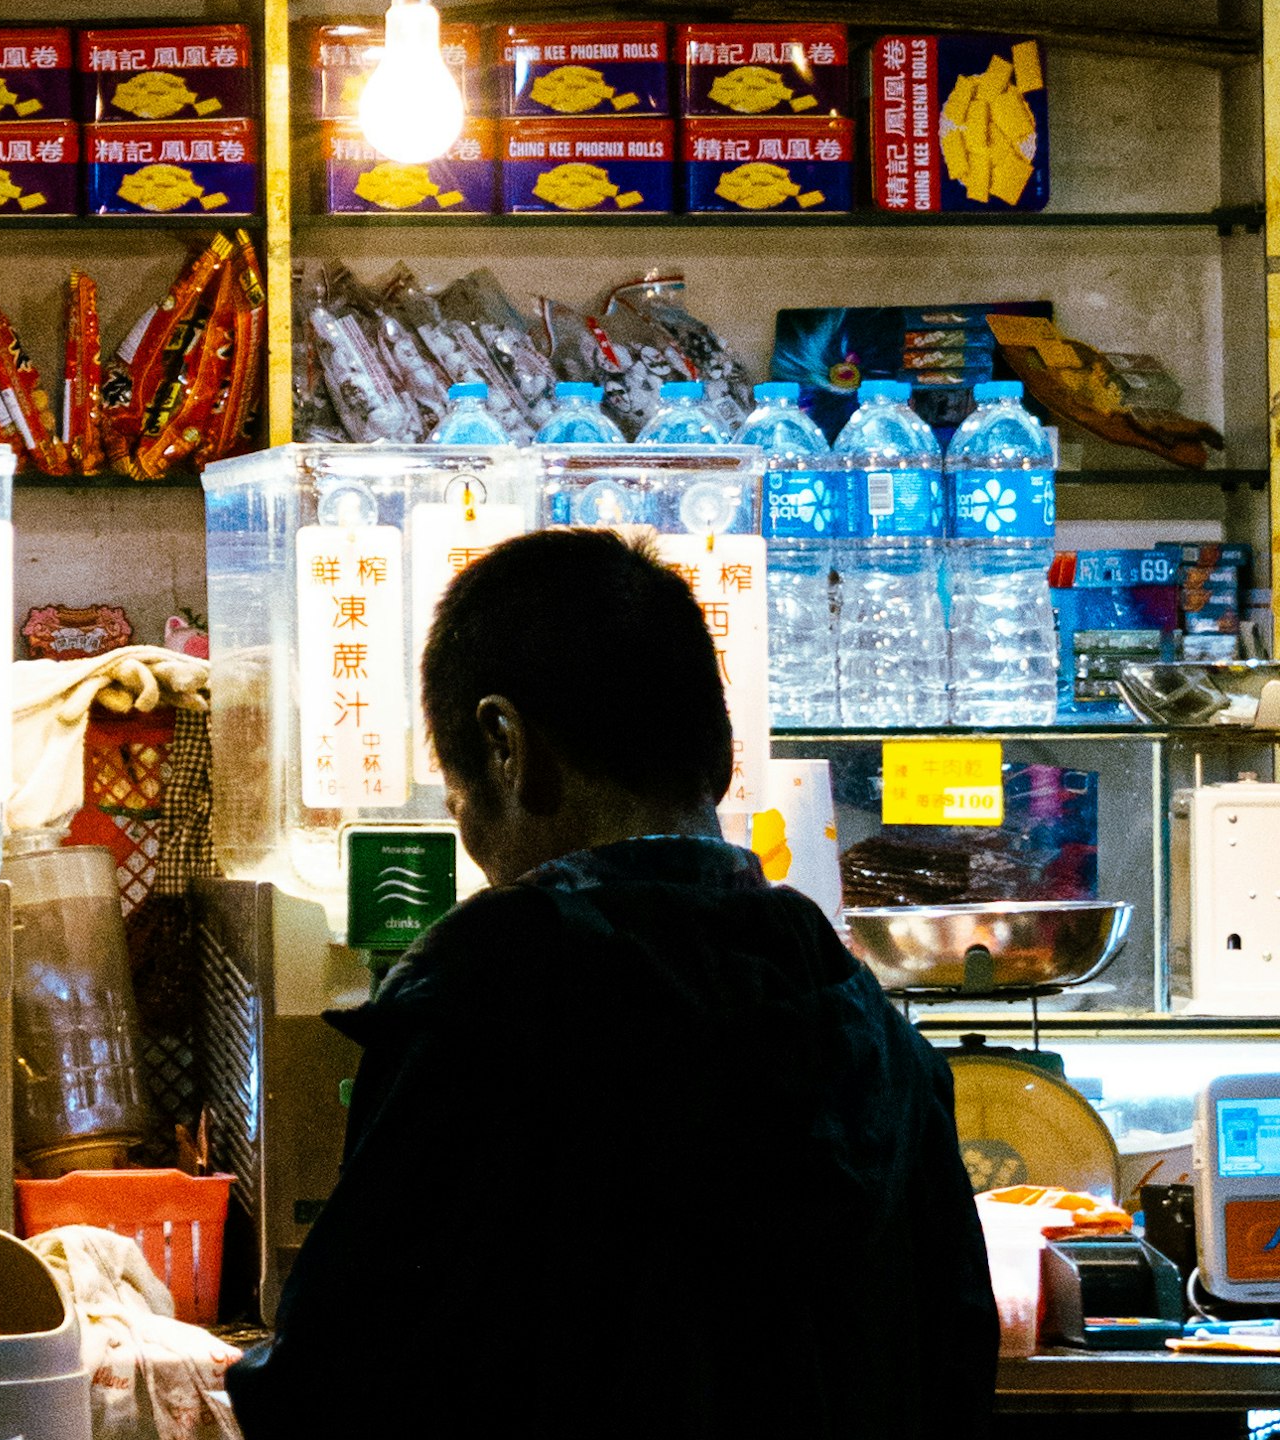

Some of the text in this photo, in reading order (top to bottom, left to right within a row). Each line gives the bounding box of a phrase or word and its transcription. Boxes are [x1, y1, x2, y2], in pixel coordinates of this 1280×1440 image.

[544, 45, 566, 61] KEE
[570, 44, 619, 60] PHOENIX
[624, 43, 658, 58] ROLLS
[911, 39, 928, 79] ROLLS
[912, 83, 929, 138] PHOENIX
[509, 141, 664, 157] CHING KEE PHOENIX ROLLS
[309, 554, 388, 588] 鮮榨
[330, 594, 370, 730] 凍蔗汁
[316, 732, 382, 776] 大杯 中杯
[385, 916, 421, 928] drinks
